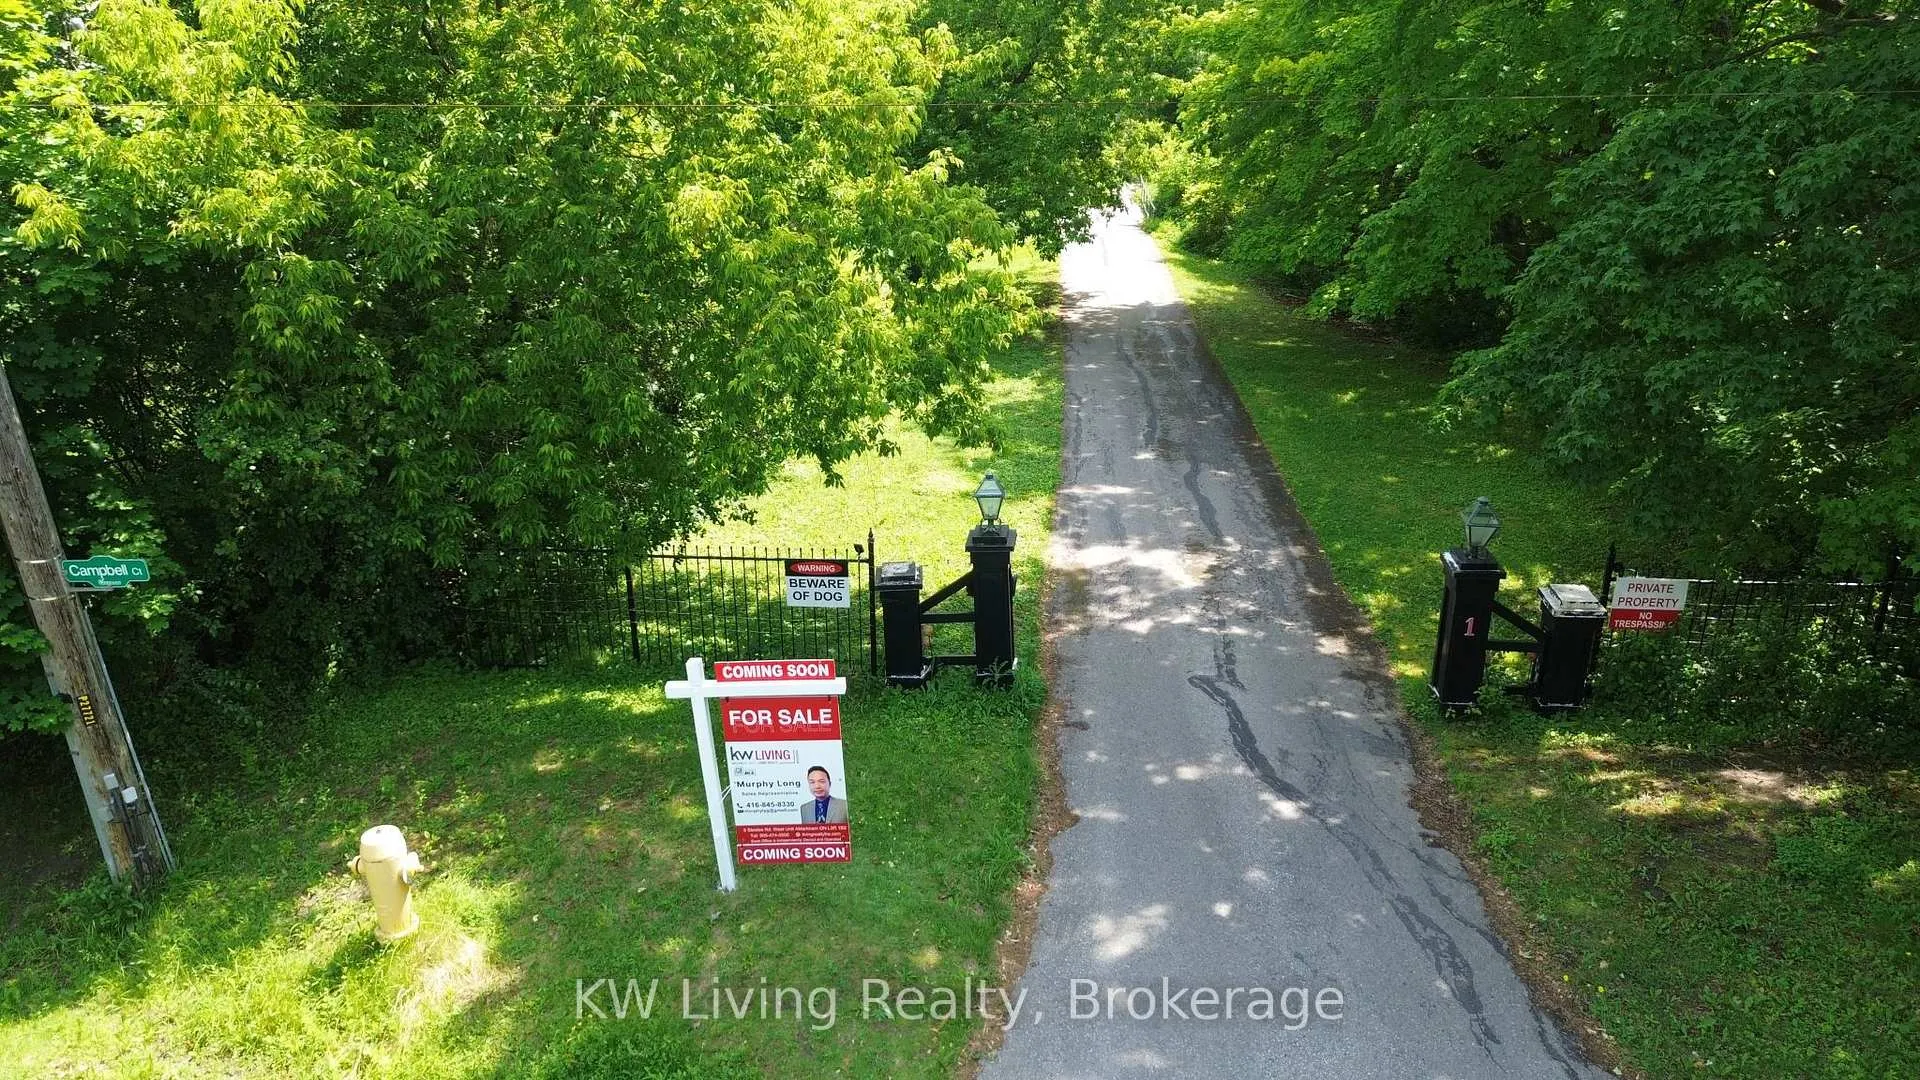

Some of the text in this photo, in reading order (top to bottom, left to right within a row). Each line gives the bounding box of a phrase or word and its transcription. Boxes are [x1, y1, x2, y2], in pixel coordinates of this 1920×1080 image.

[68, 564, 128, 579] Campbell
[797, 564, 836, 573] WARNING
[789, 578, 845, 589] BEWARE
[1627, 582, 1675, 594] PRIVATE
[792, 591, 843, 602] OF DOG
[1617, 596, 1680, 608] PROPERTY
[1639, 612, 1653, 620] NO
[1463, 616, 1475, 636] 1
[722, 663, 829, 679] COMING SOON
[728, 708, 833, 726] FOR SALE
[755, 749, 791, 761] LIVING
[736, 780, 801, 788] Murphy Long
[743, 847, 846, 860] COMING SOON
